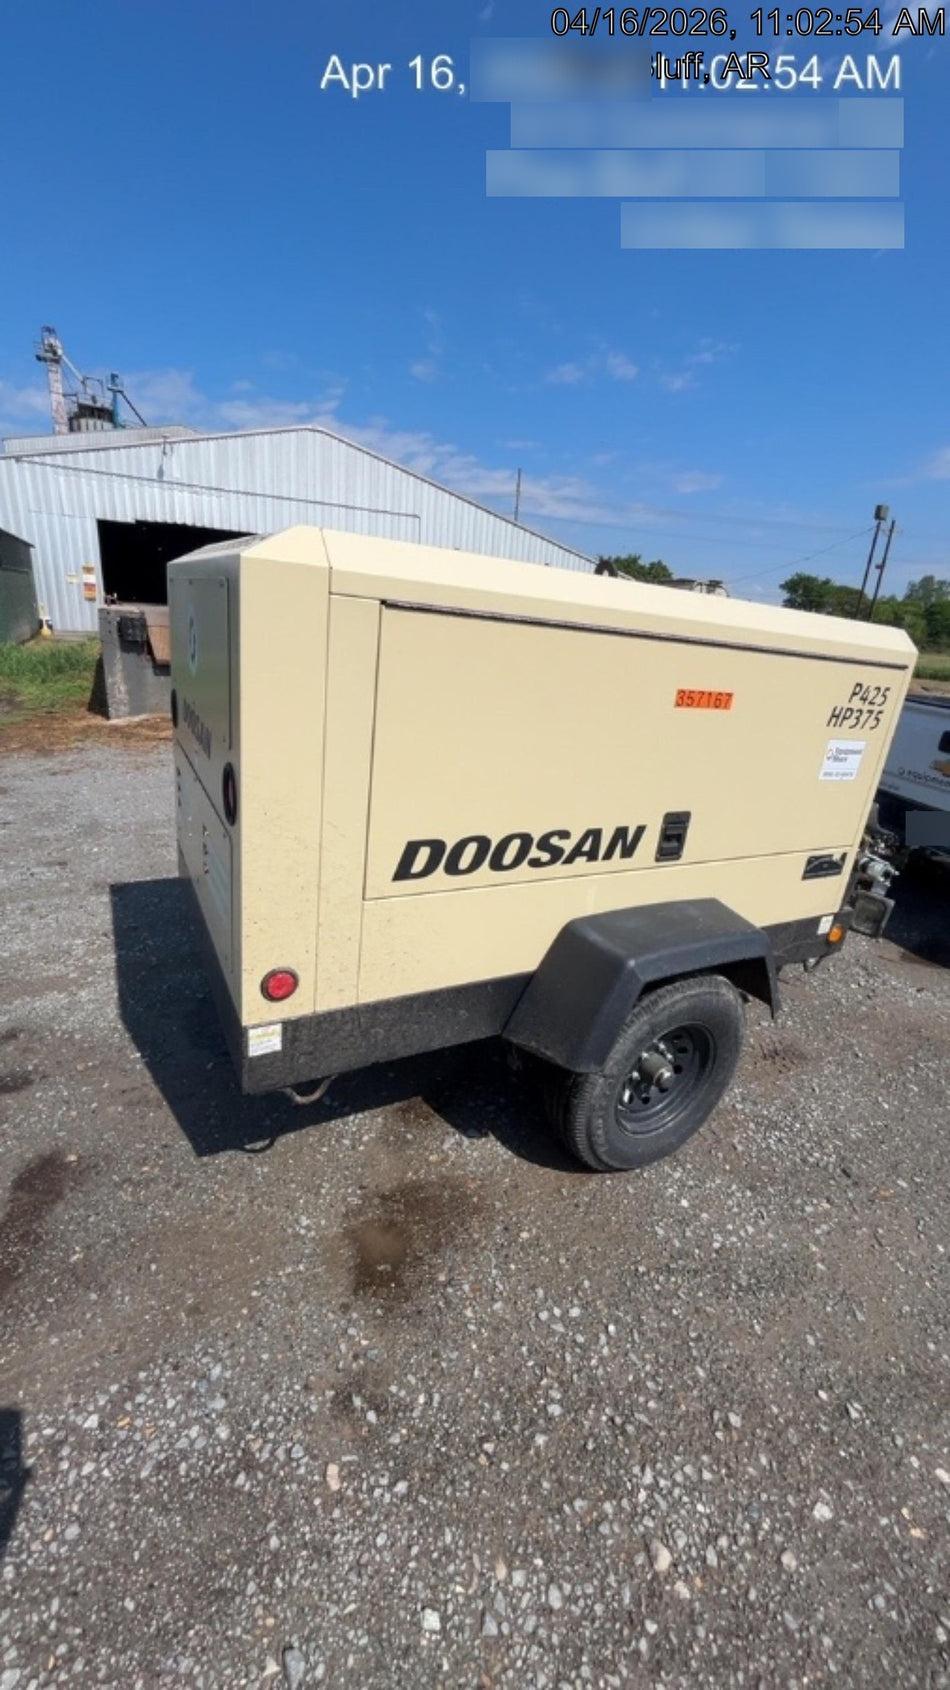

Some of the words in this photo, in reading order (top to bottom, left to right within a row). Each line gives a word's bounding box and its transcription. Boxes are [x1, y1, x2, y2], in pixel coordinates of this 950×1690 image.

[676, 689, 733, 710] 357167
[848, 682, 891, 707] P425
[826, 705, 884, 731] HP375
[392, 824, 648, 882] DOOSAN
